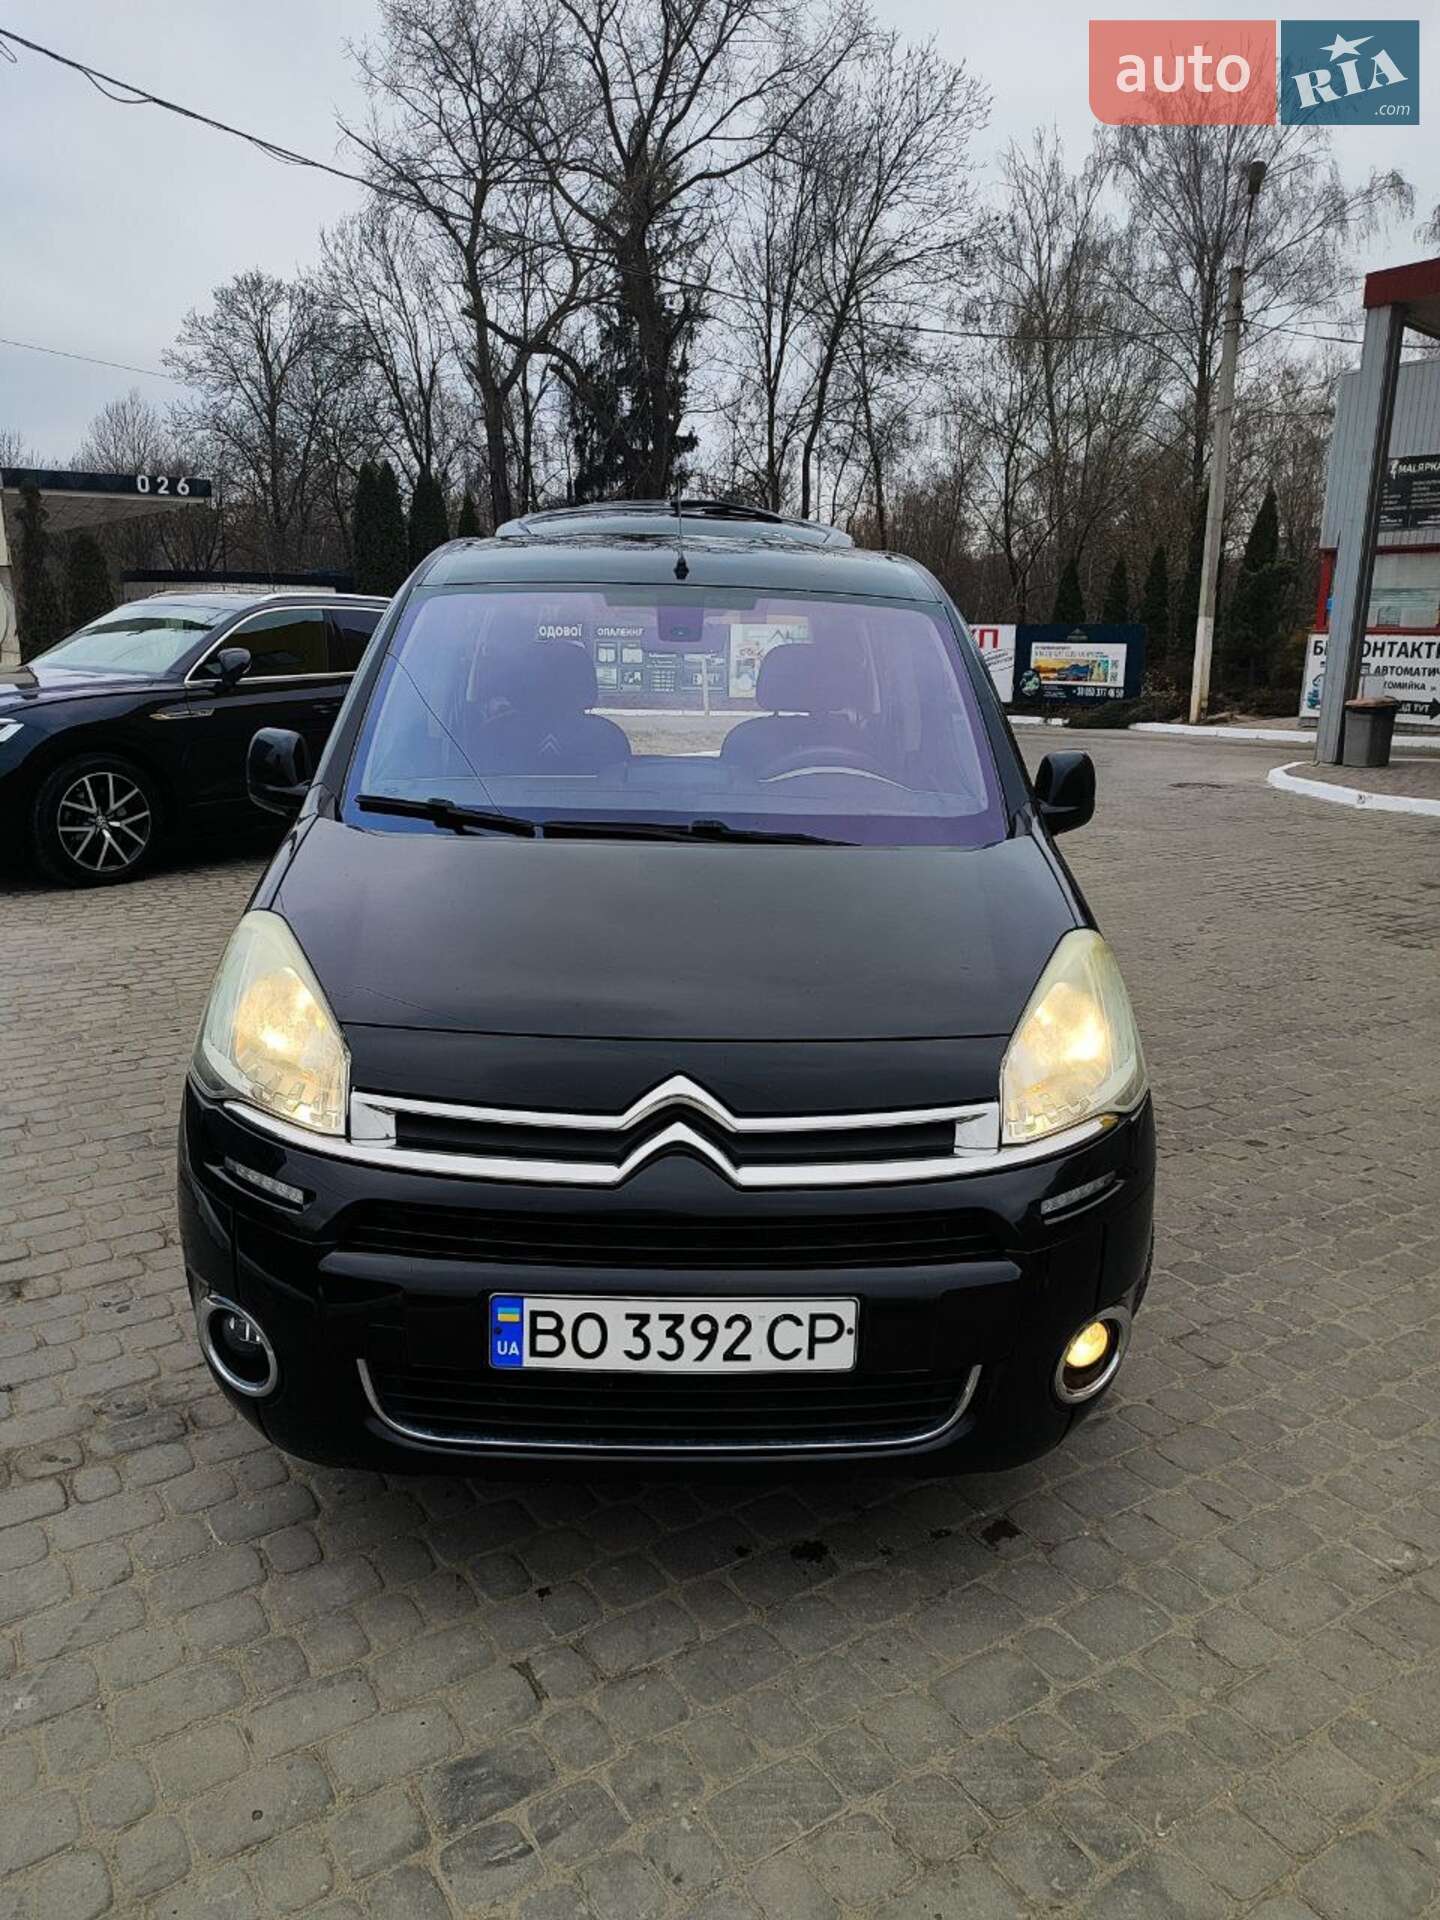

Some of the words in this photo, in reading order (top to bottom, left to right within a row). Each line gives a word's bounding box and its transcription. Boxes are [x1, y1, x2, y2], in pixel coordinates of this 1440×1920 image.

[136, 474, 190, 496] 026
[529, 1310, 609, 1360] BO
[623, 1313, 752, 1362] 3392
[766, 1313, 845, 1361] CP
[496, 1341, 520, 1356] UA
